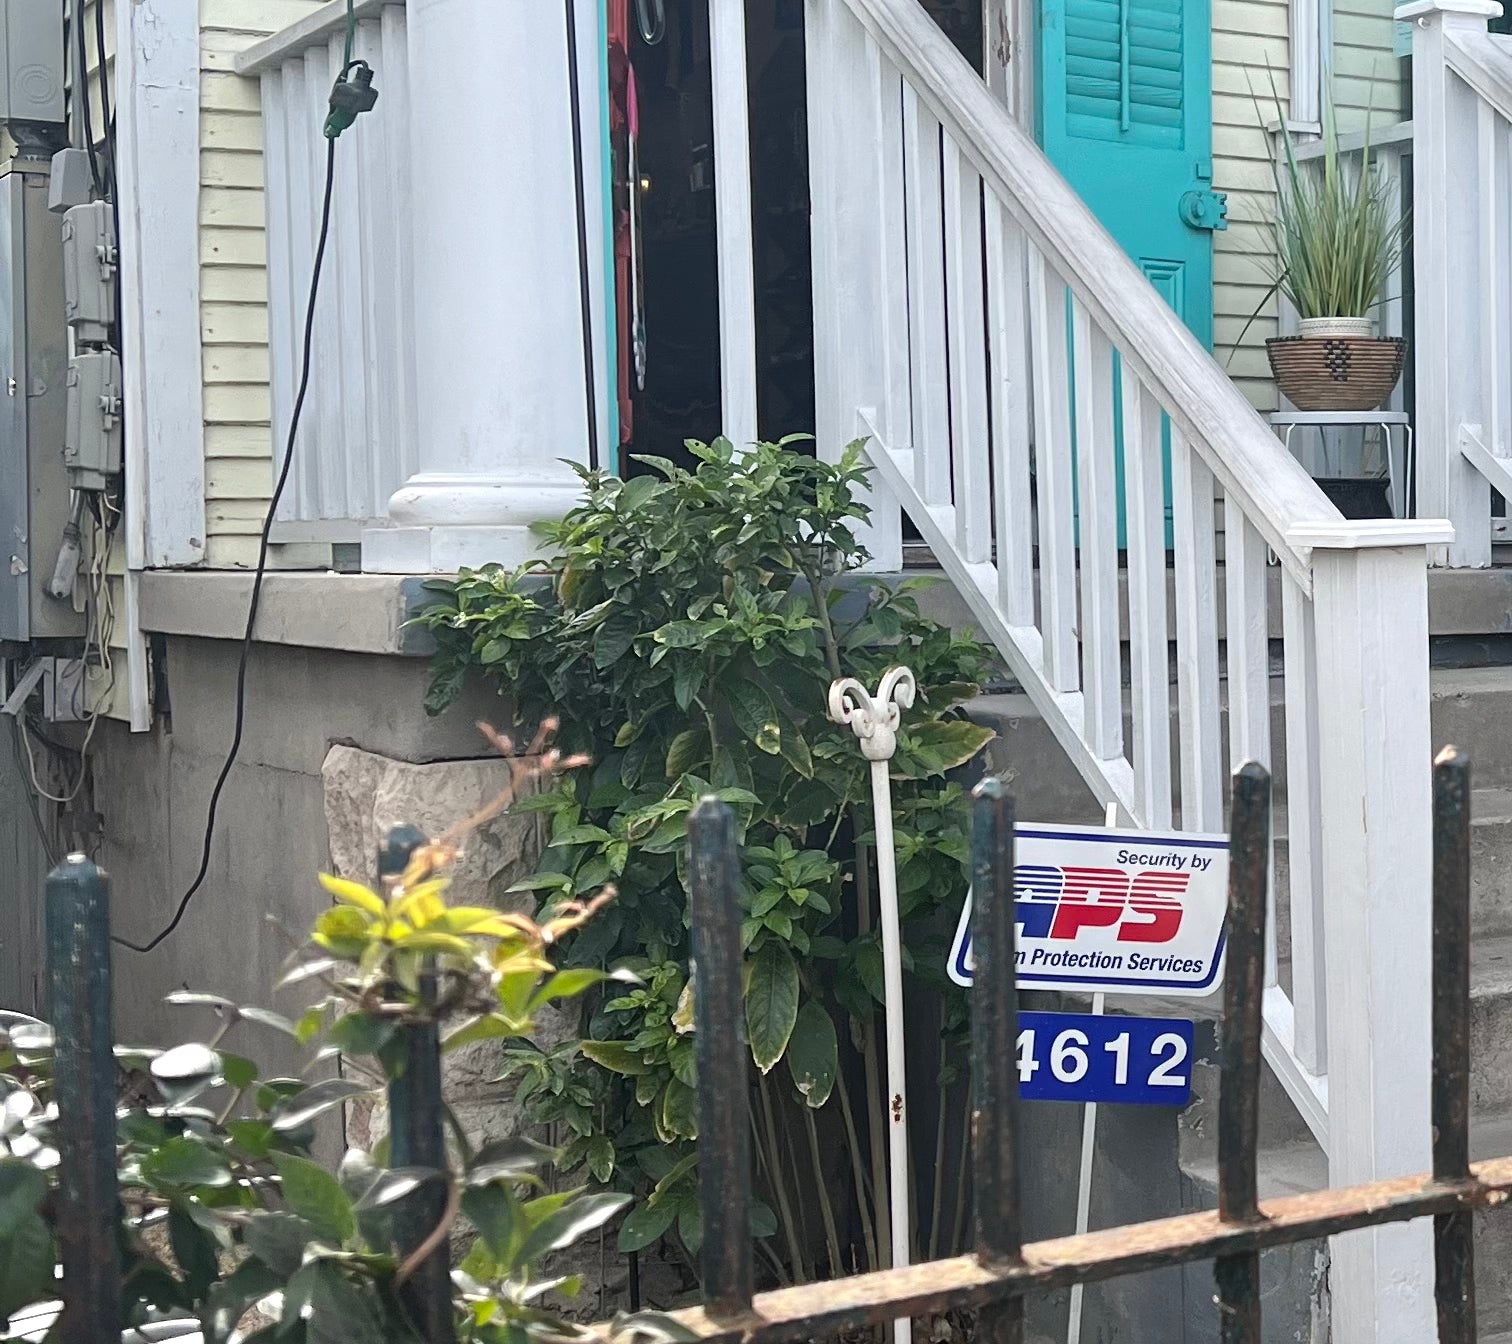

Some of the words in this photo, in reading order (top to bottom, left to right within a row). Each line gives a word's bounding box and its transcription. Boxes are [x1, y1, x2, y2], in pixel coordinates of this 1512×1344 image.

[1116, 850, 1187, 871] Security
[1191, 853, 1212, 872] by
[1031, 948, 1123, 970] Protection
[1127, 952, 1203, 974] Services
[1015, 1028, 1188, 1087] 4612
